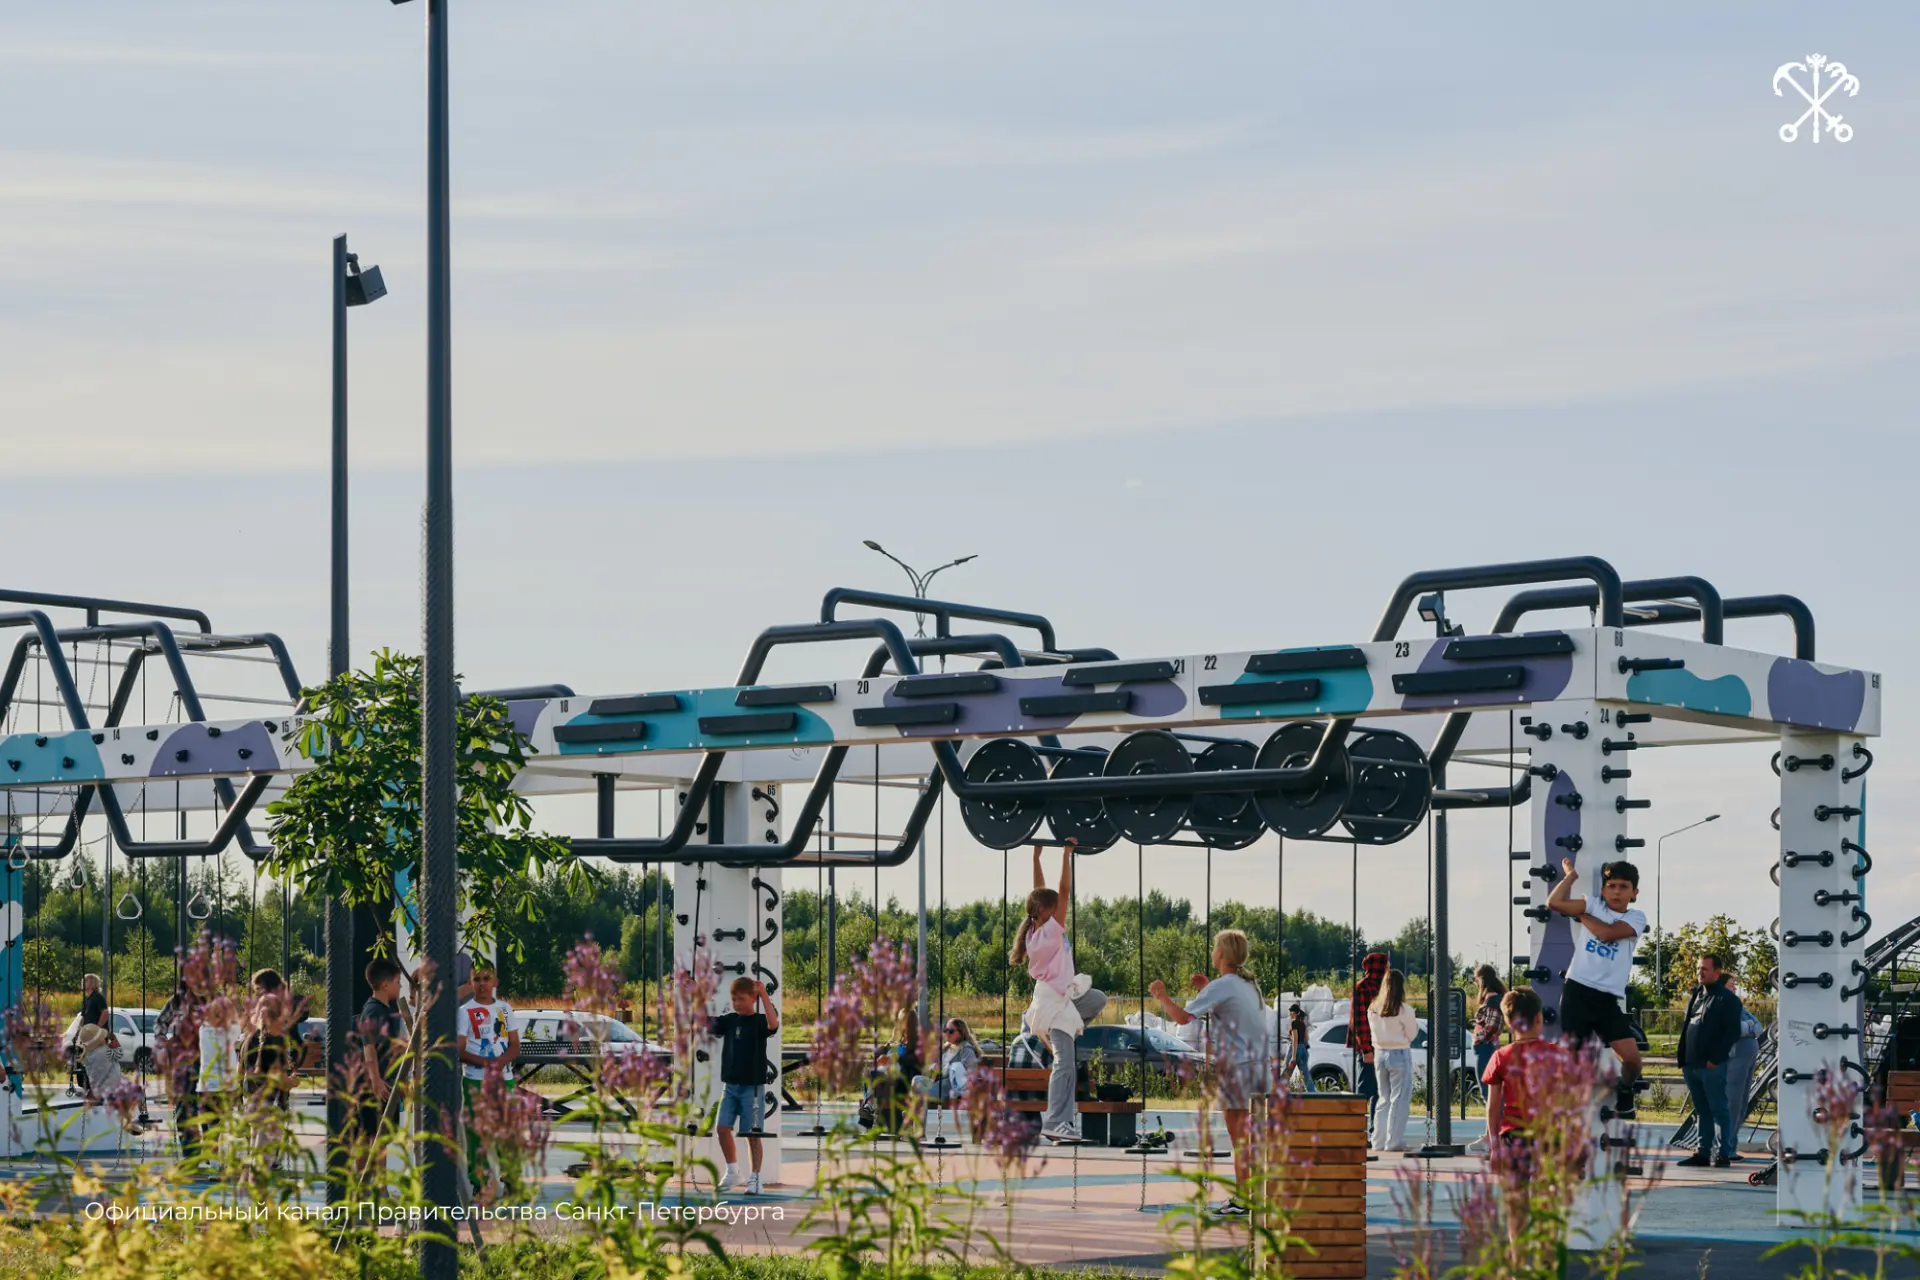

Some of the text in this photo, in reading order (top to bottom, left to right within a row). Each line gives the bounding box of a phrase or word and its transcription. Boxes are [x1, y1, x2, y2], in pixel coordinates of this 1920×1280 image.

[1395, 642, 1409, 658] 23
[1174, 659, 1185, 674] 21
[1204, 655, 1217, 670] 22
[857, 680, 869, 694] 20
[560, 700, 569, 713] 18
[1600, 707, 1610, 723] 24
[281, 720, 290, 732] 15
[112, 728, 121, 740] 14
[767, 784, 776, 796] 65
